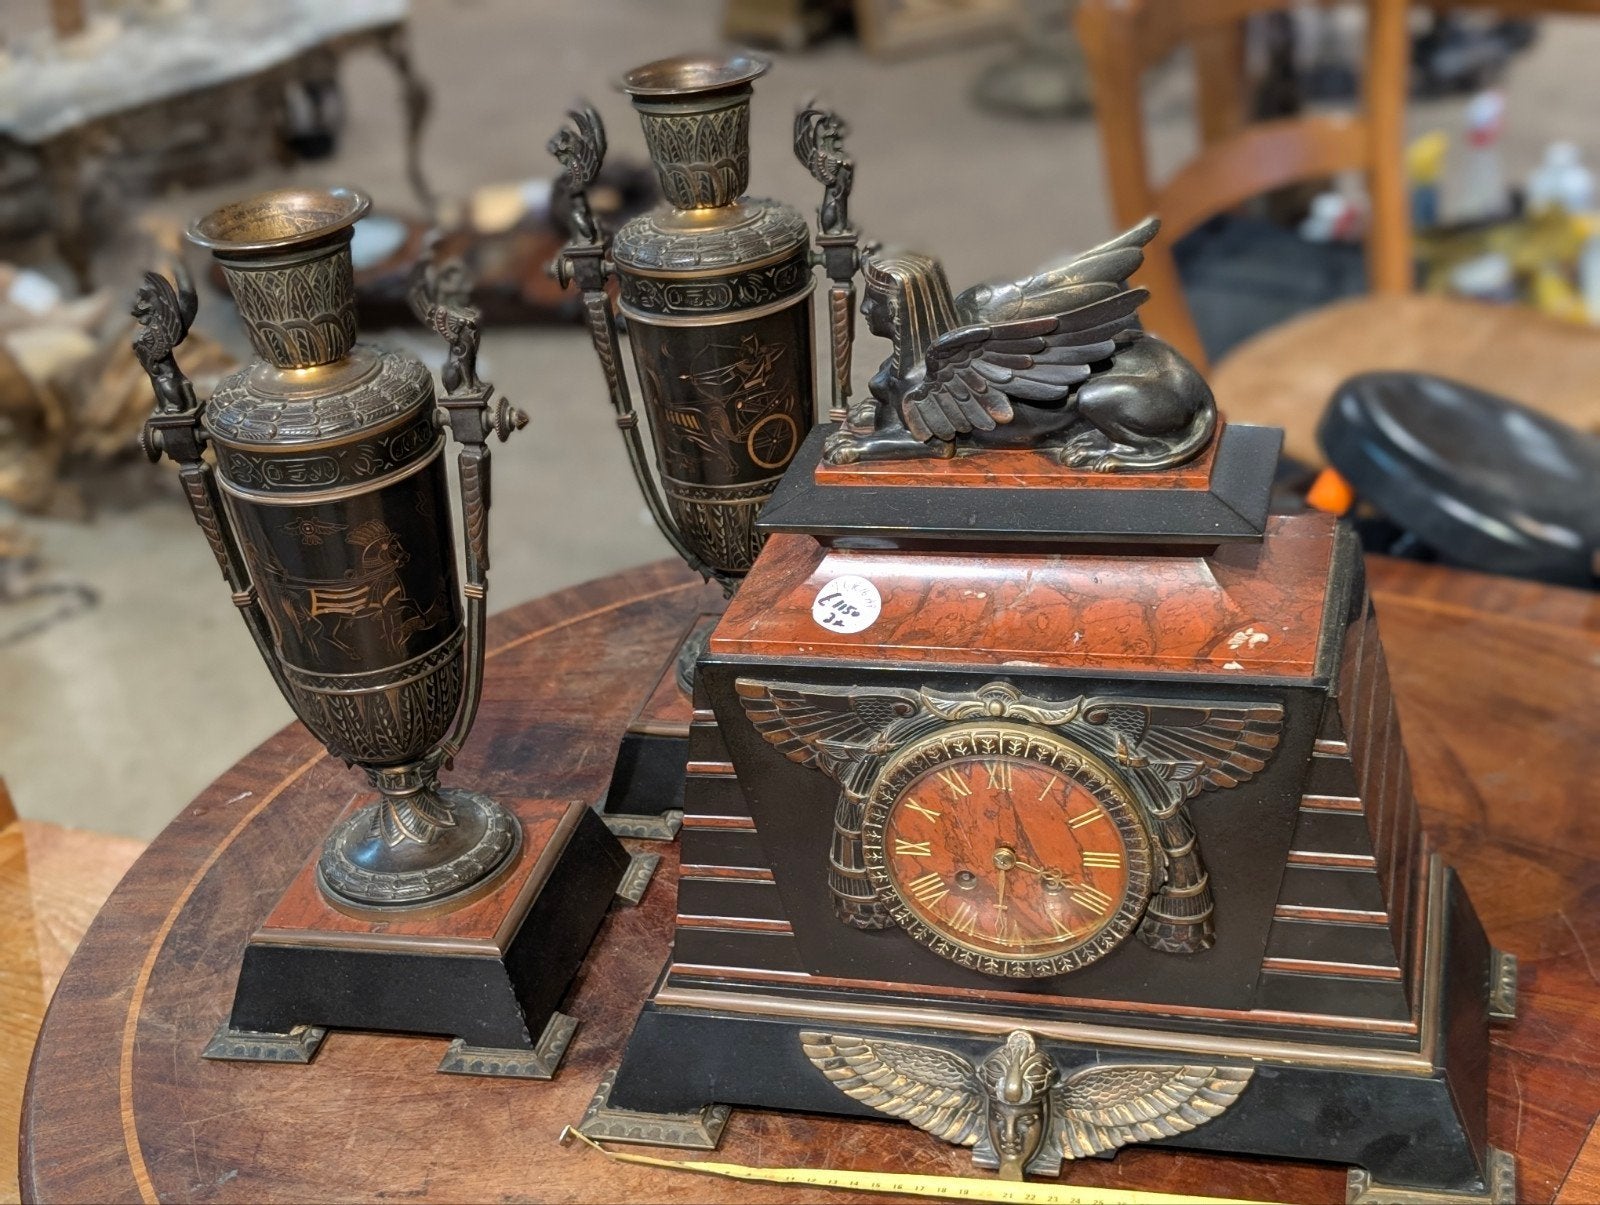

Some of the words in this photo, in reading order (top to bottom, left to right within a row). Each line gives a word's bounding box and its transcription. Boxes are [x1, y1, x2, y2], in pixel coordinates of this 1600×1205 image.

[904, 797, 942, 824] X
[895, 838, 932, 857] IX
[1082, 851, 1121, 869] III
